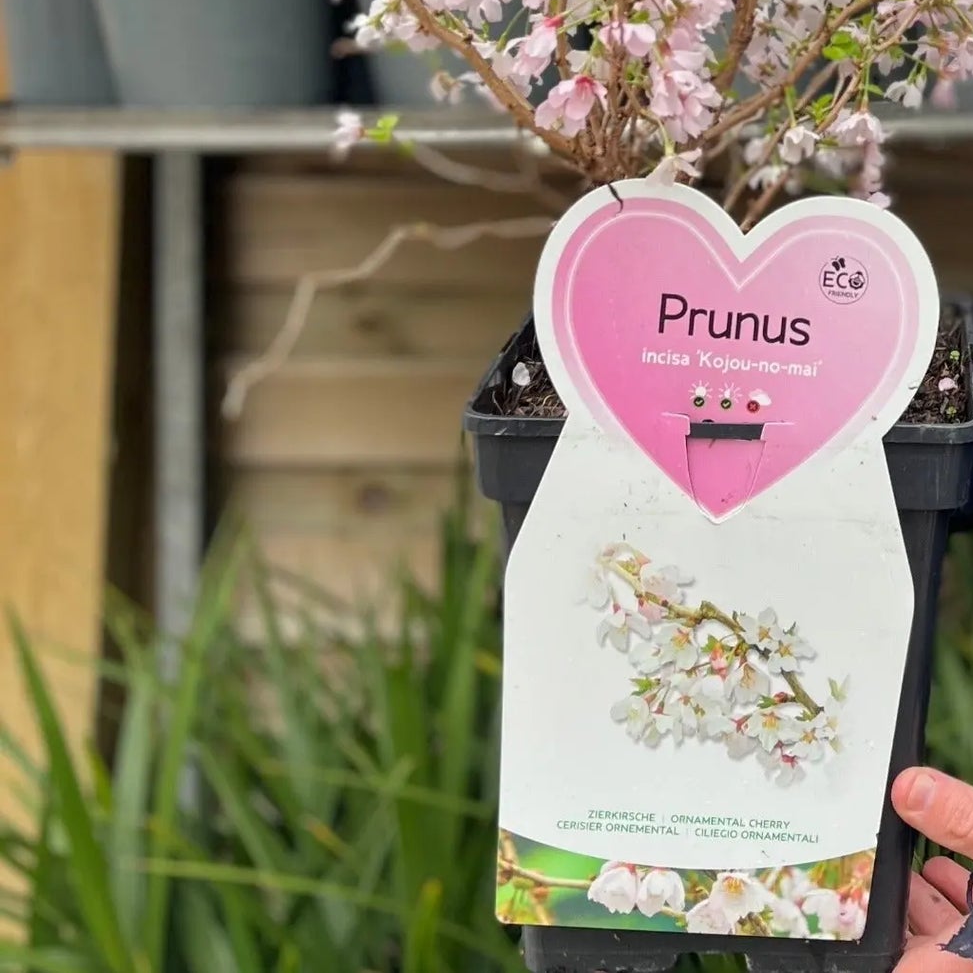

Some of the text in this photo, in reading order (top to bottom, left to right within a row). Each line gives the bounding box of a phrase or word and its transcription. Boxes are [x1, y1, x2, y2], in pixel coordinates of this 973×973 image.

[823, 271, 865, 290] ECO
[827, 290, 859, 298] FRIENDLY
[658, 293, 811, 346] Prunus
[641, 347, 690, 366] incisa
[588, 810, 790, 829] ZIERKIRSCHE ORNAMENTAL CHERRY
[556, 820, 819, 844] CERISIER ORNEMENTAL CILIEGIO ORNAMENTALI
